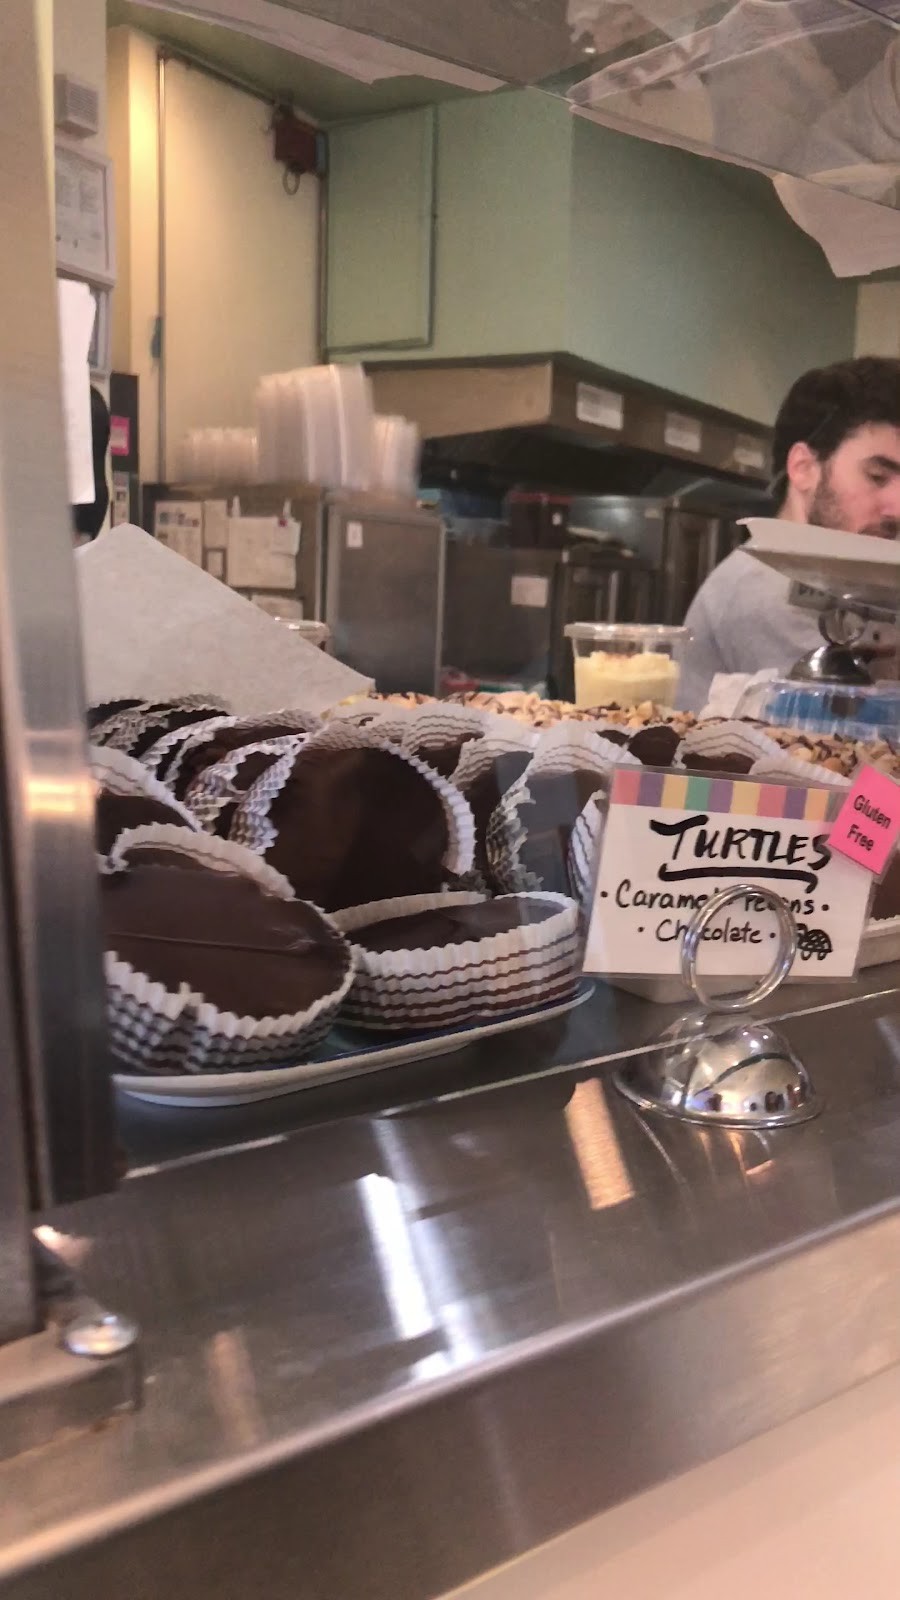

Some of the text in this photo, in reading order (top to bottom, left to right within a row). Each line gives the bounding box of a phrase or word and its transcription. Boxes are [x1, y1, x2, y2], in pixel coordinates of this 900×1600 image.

[854, 794, 891, 829] Gluten
[650, 815, 831, 870] TURTLES
[847, 824, 874, 851] Free
[615, 879, 719, 908] Carame
[656, 917, 762, 943] Chcolate
